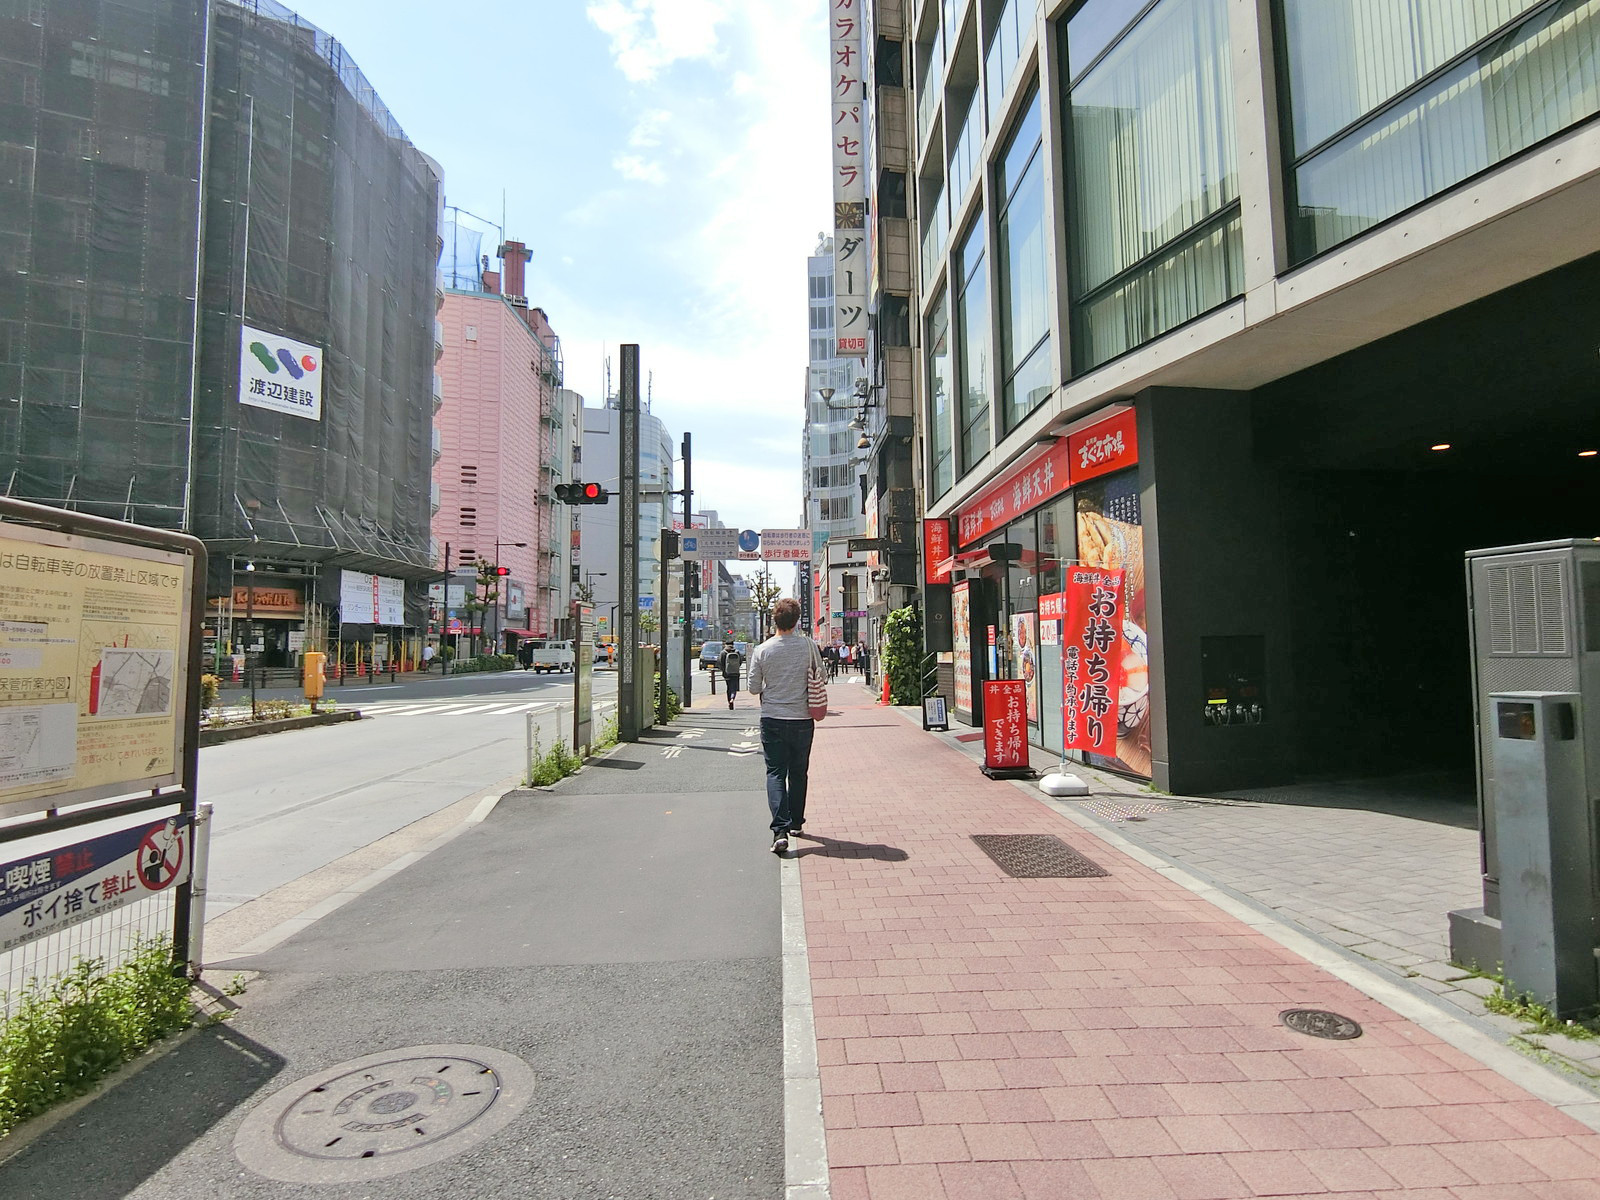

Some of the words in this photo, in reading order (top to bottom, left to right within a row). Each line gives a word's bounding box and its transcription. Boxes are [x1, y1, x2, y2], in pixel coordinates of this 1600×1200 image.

[839, 236, 864, 329] ダーツ
[838, 337, 866, 350] 貸切可
[249, 377, 314, 408] 渡辺建設
[1078, 430, 1125, 469] まぐろ市場
[0, 554, 180, 589] は自転車等の放置禁止区域です
[764, 549, 809, 558] 歩行者優先
[1079, 586, 1118, 749] お持ち帰り
[1065, 645, 1080, 744] 電話予約承ります
[992, 718, 1007, 764] できます
[1006, 695, 1022, 764] お持ち帰り
[23, 869, 137, 928] ポイ捨て禁止
